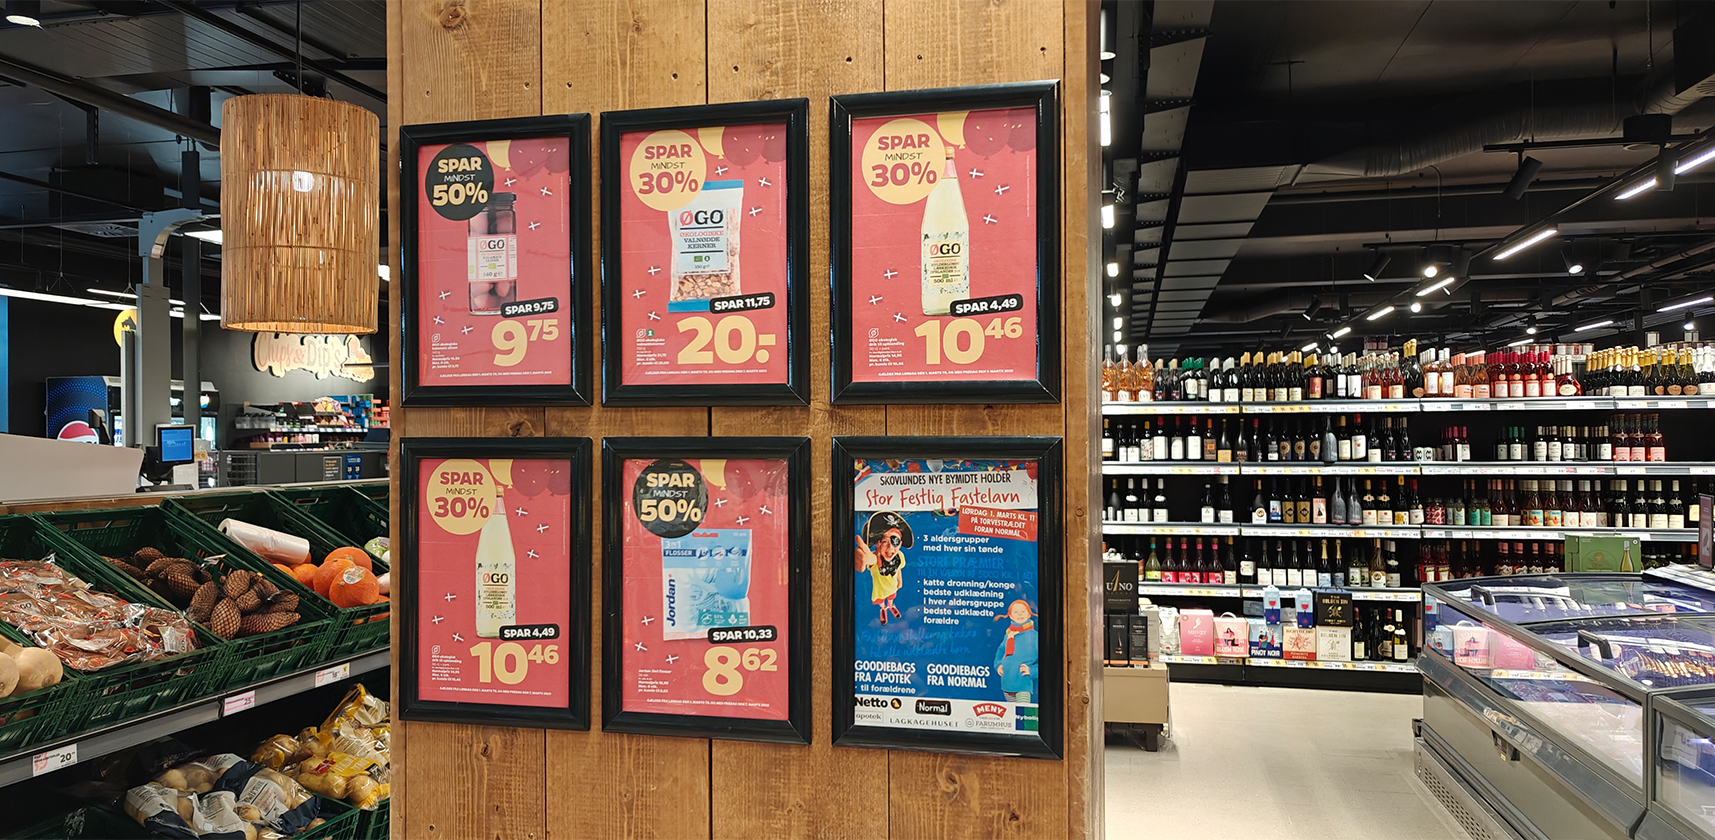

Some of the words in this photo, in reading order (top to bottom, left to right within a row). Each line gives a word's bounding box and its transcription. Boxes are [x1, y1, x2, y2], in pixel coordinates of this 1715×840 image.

[877, 134, 931, 150] SPAR
[644, 144, 692, 160] SPAR
[884, 152, 923, 161] MINDST
[437, 157, 482, 173] SPAR
[650, 162, 686, 170] MINDST
[443, 174, 475, 182] MINDST
[871, 162, 938, 187] 30%
[638, 171, 698, 194] 30%
[432, 181, 489, 206] 50%
[680, 210, 724, 226] ØGO
[479, 239, 505, 250] ØGO
[930, 243, 961, 255] ØGO
[505, 304, 533, 316] SPAR
[533, 301, 555, 313] 9,75
[714, 299, 744, 311] SPAR
[744, 296, 771, 309] 11,75
[955, 301, 988, 314] SPAR
[989, 298, 1018, 311] 4,49
[439, 471, 484, 486] SPAR
[646, 473, 695, 488] SPAR
[880, 475, 926, 486] SKOVLUNDES
[928, 474, 943, 484] NYE
[945, 473, 978, 484] BYMIDTE
[980, 472, 1011, 484] HOLDER
[445, 487, 478, 495] MINDST
[652, 489, 688, 498] MINDST
[865, 489, 893, 508] Stor
[900, 487, 944, 509] Festlig
[950, 486, 1020, 507] Fastelavn
[434, 497, 489, 519] 30%
[640, 500, 702, 523] 50%
[961, 507, 988, 517] LØRDAG
[997, 511, 1017, 520] MARTS
[970, 515, 979, 523] PÅ
[980, 517, 1026, 529] TORVESTRÆDET
[974, 525, 993, 534] FORAN
[994, 526, 1021, 537] NORMAL
[930, 535, 990, 544] aldersgrupper
[923, 544, 941, 552] med
[944, 545, 962, 553] hver
[963, 545, 976, 553] sin
[978, 545, 1003, 554] tønde
[917, 556, 949, 568] STORE
[952, 556, 1004, 569] PRÆMIER
[483, 573, 508, 583] ØGO
[923, 578, 945, 587] katte
[947, 579, 1015, 590] dronning/konge
[923, 588, 952, 596] bedste
[954, 588, 1004, 600] udklædning
[666, 578, 676, 627] Jordan
[928, 598, 946, 606] hver
[948, 599, 1005, 608] aldersgruppe
[923, 607, 952, 615] bedste
[954, 608, 994, 617] udklædte
[923, 616, 959, 625] forældre
[503, 629, 531, 638] SPAR
[532, 627, 555, 638] 4,49
[713, 630, 742, 641] SPAR
[743, 628, 773, 640] 10,33
[854, 660, 916, 673] GOODIEBAGS
[926, 663, 990, 677] GOODIEBAGS
[855, 672, 872, 683] FRA
[874, 672, 911, 684] APOTEK
[927, 675, 945, 686] FRA
[947, 676, 987, 688] NORMAL
[860, 684, 869, 692] til
[871, 684, 916, 694] forældrene
[855, 697, 888, 708] Netto
[919, 702, 948, 713] Normal
[976, 704, 1003, 715] MENY
[890, 718, 959, 728] LAGKAGEHUSET
